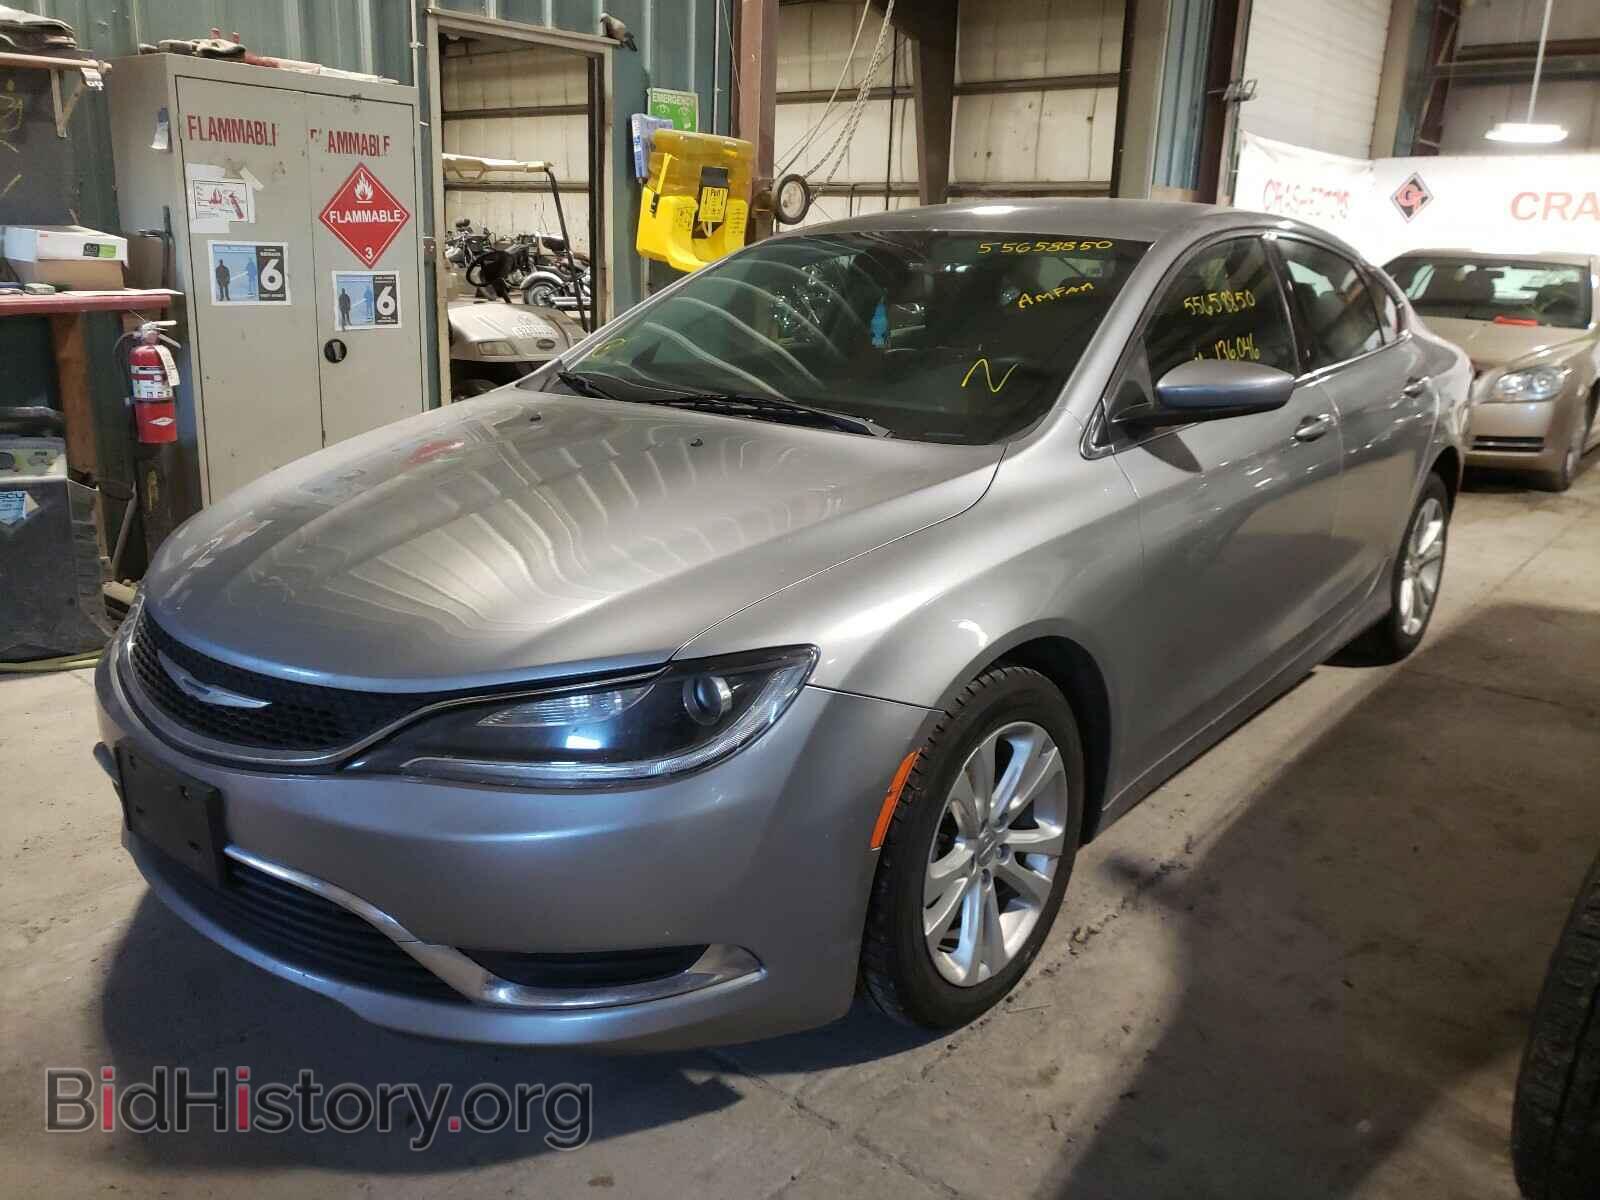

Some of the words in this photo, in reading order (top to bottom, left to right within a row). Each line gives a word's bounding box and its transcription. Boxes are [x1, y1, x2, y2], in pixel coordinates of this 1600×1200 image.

[329, 209, 401, 224] FLAMMABLE
[1510, 191, 1600, 221] CRA
[365, 247, 373, 260] 3
[260, 258, 283, 292] 6
[376, 285, 396, 316] 6
